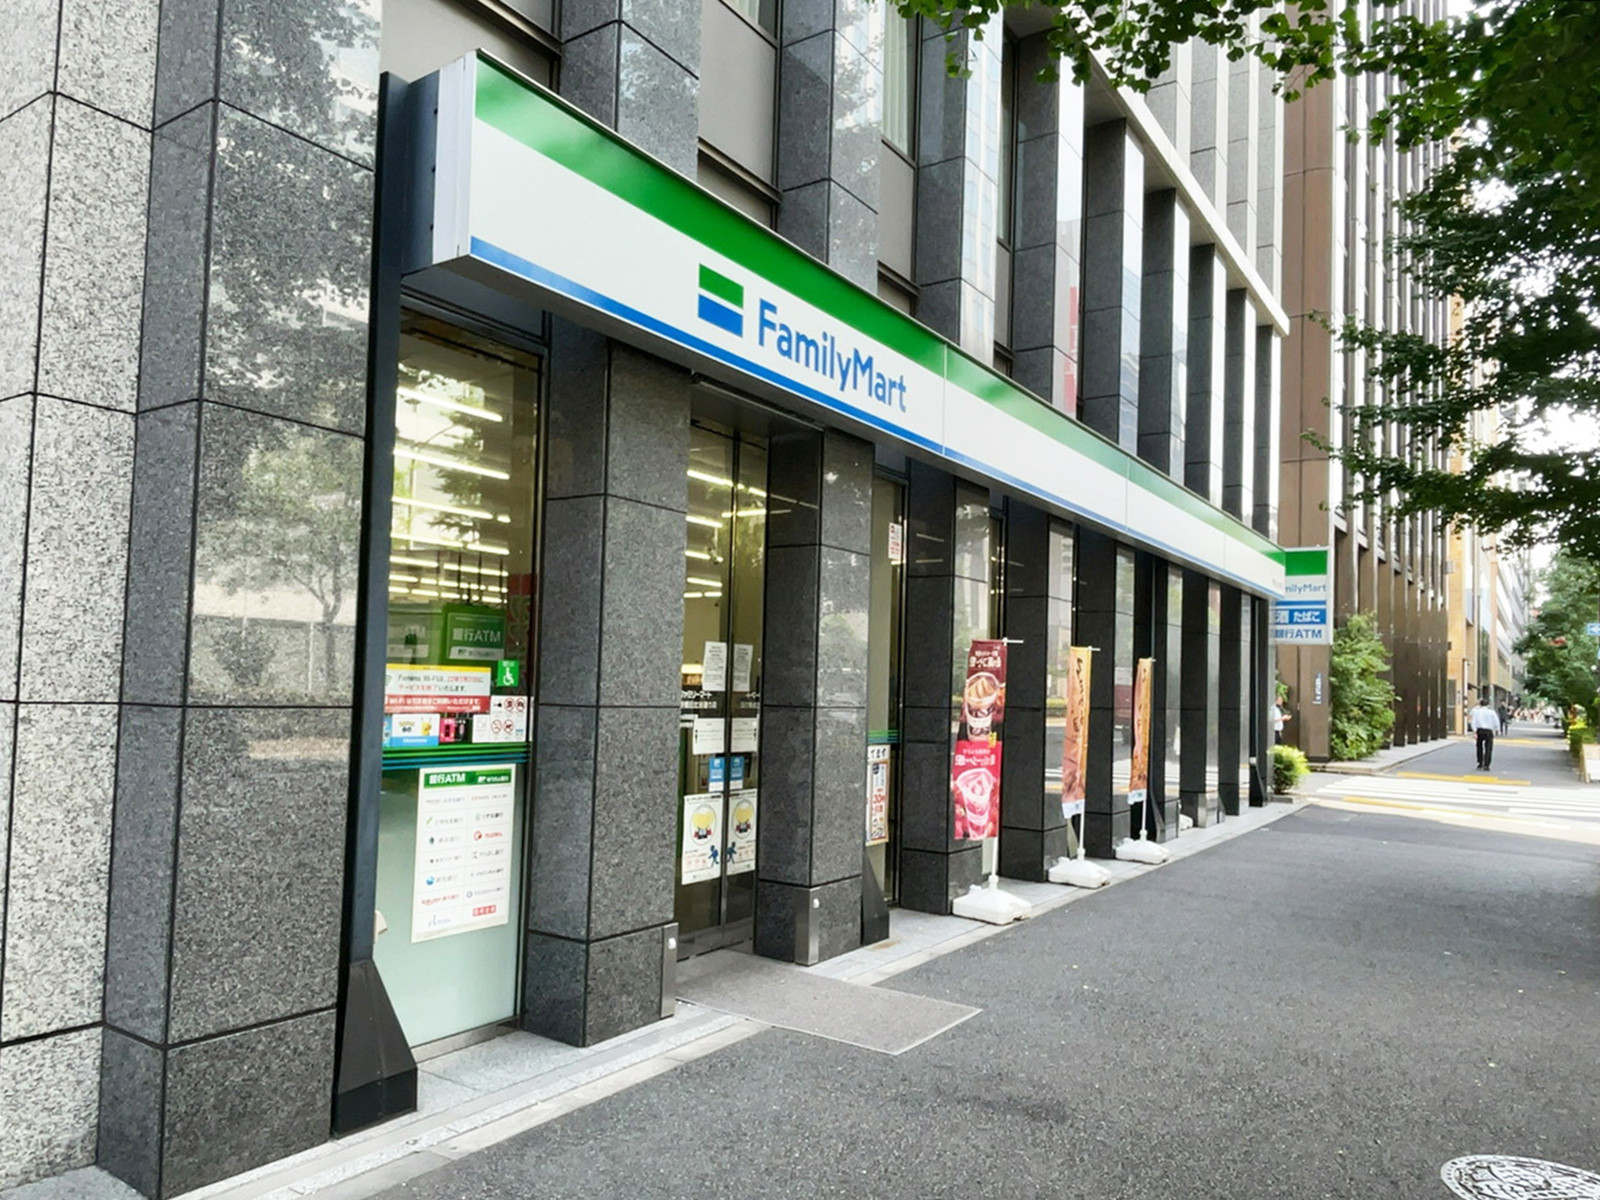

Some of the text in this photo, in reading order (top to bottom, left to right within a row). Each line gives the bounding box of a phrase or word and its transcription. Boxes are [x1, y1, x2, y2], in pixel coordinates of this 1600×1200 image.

[758, 297, 907, 413] FamilyMart
[1293, 610, 1321, 622] たばこ
[452, 627, 501, 642] 銀行ATM
[1275, 628, 1322, 639] 銀行ATM
[429, 773, 466, 785] 銀行ATM
